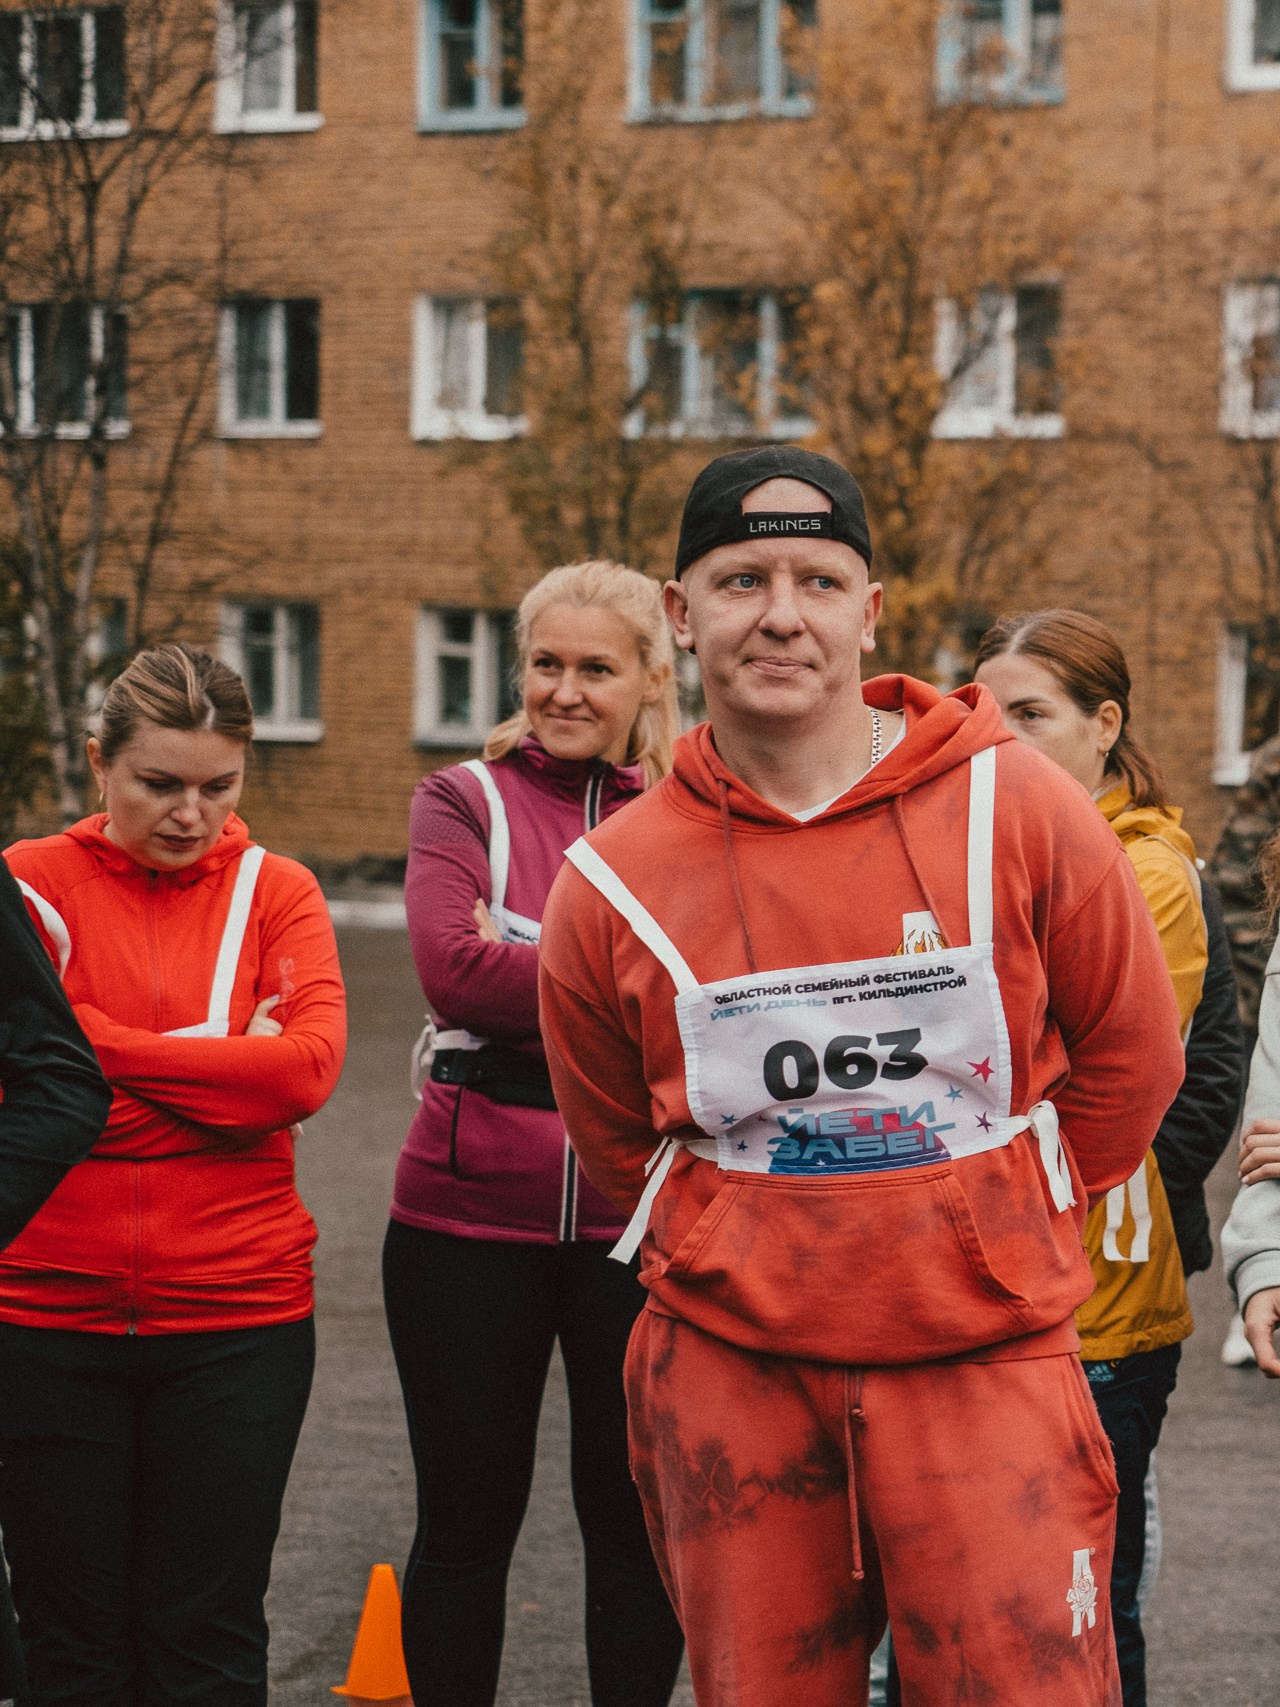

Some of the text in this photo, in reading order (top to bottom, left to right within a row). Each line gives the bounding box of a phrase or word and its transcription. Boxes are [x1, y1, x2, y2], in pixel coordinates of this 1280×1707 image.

[750, 519, 820, 532] LAKINGS
[710, 999, 761, 1021] ЙЕТИ
[763, 997, 827, 1012] ДЕНЬ
[858, 975, 967, 1002] КИЛЬДИНСТРОЙ
[714, 964, 954, 1005] ОБЛАСТНОЙ СЕМЕЙНЫЙ ФЕСТИВАЛЬ
[763, 1027, 929, 1101] 063
[776, 1100, 938, 1135] ЙЕТИ
[766, 1121, 956, 1160] ЗАБЕГ
